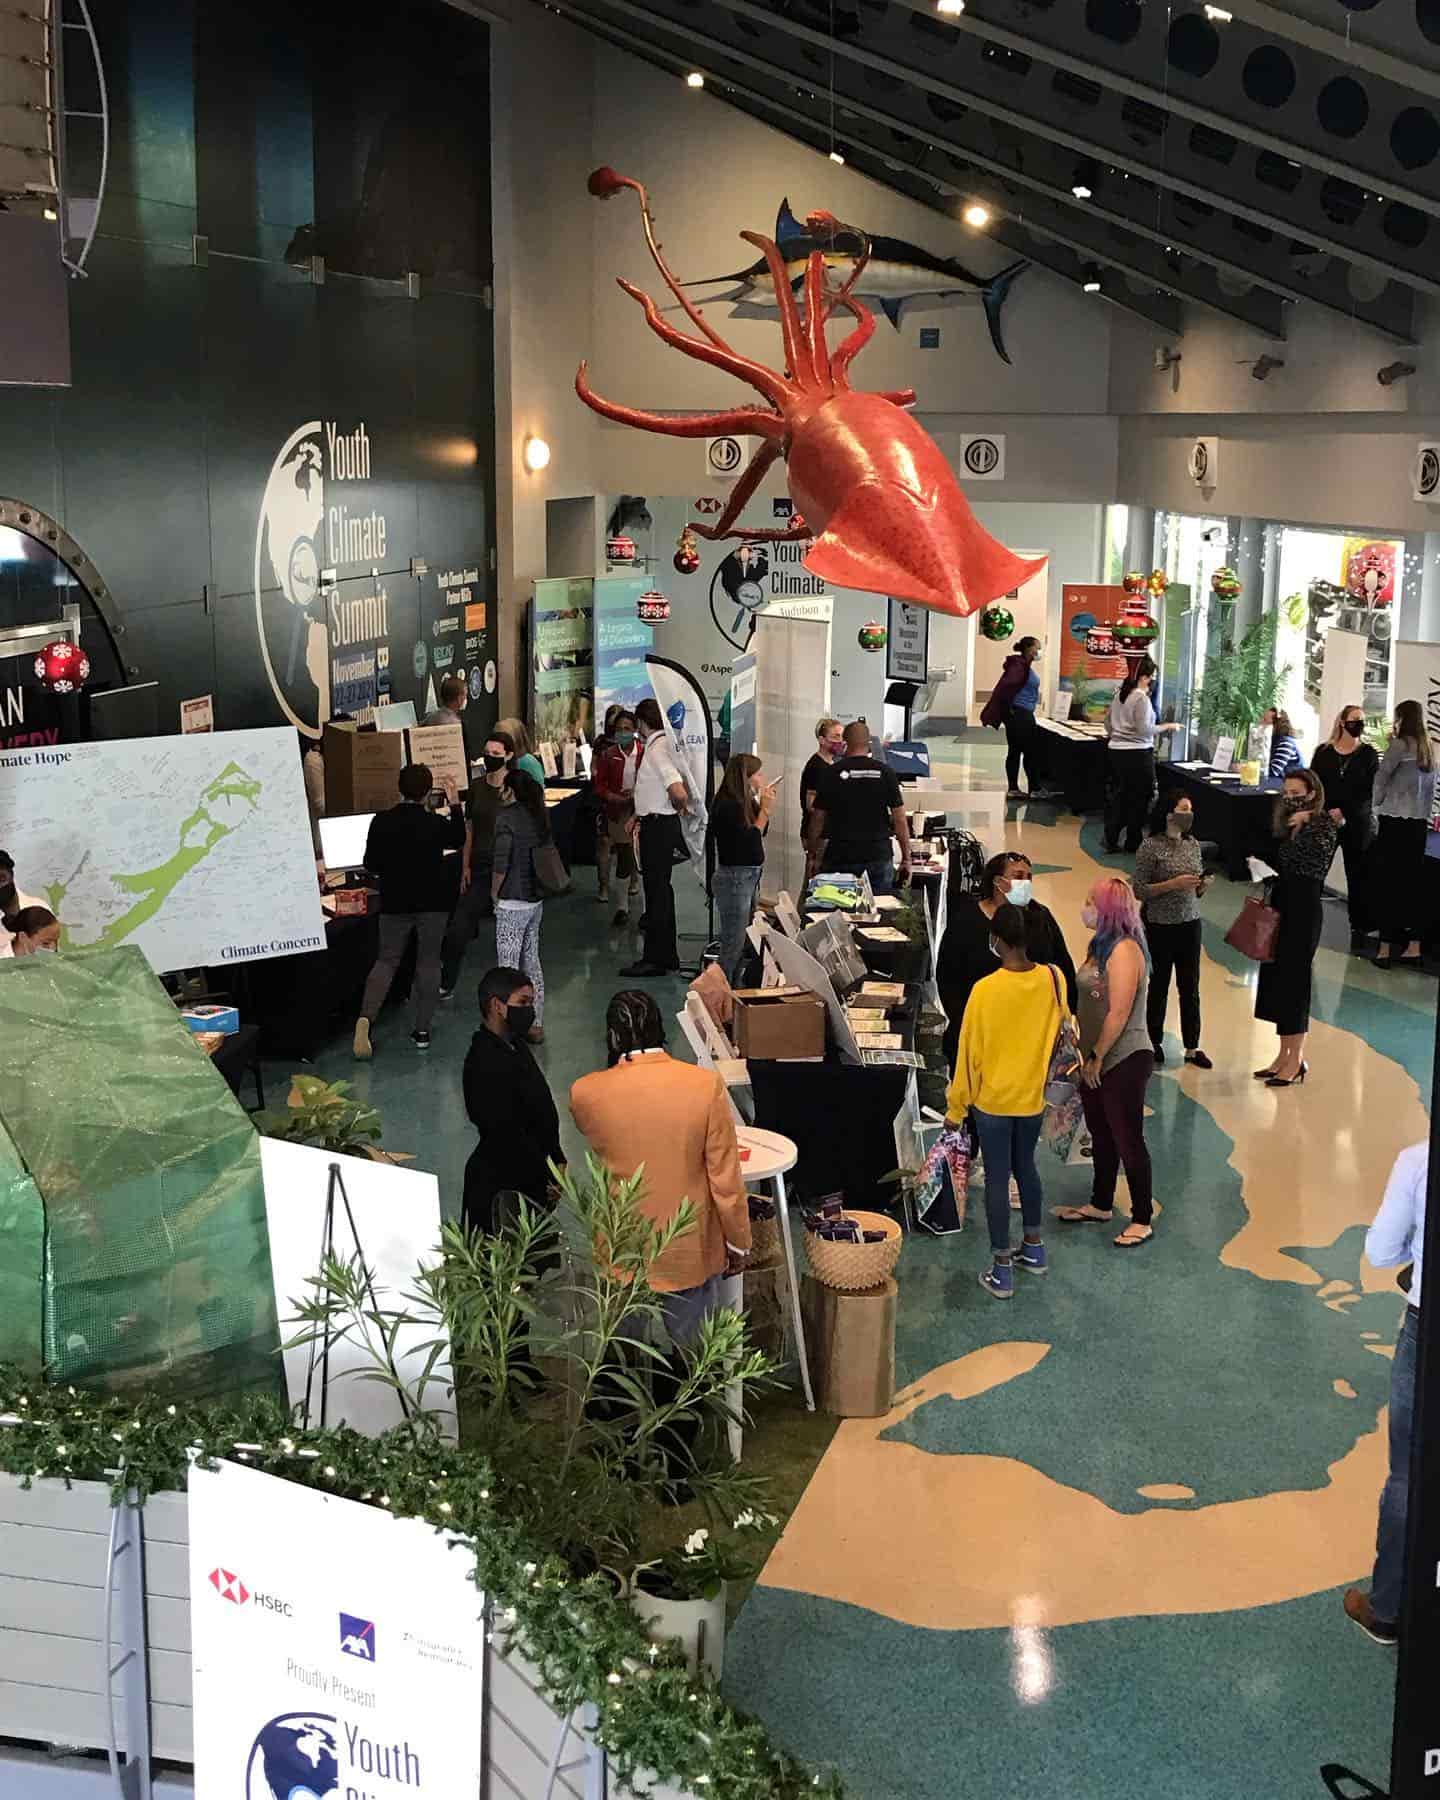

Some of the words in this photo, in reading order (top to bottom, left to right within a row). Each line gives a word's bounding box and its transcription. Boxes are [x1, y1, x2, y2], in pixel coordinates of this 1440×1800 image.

[325, 422, 370, 481] Youth
[328, 506, 386, 564] Climate
[771, 571, 824, 595] Climate
[331, 584, 388, 647] Summit
[780, 605, 819, 617] Audubon
[332, 653, 375, 687] November
[35, 751, 72, 766] Hope
[221, 944, 269, 960] Climate
[270, 936, 321, 953] Concern
[254, 1591, 293, 1618] HSBC
[286, 1656, 329, 1694] Proudly
[332, 1675, 376, 1709] Present
[344, 1720, 421, 1787] Youth
